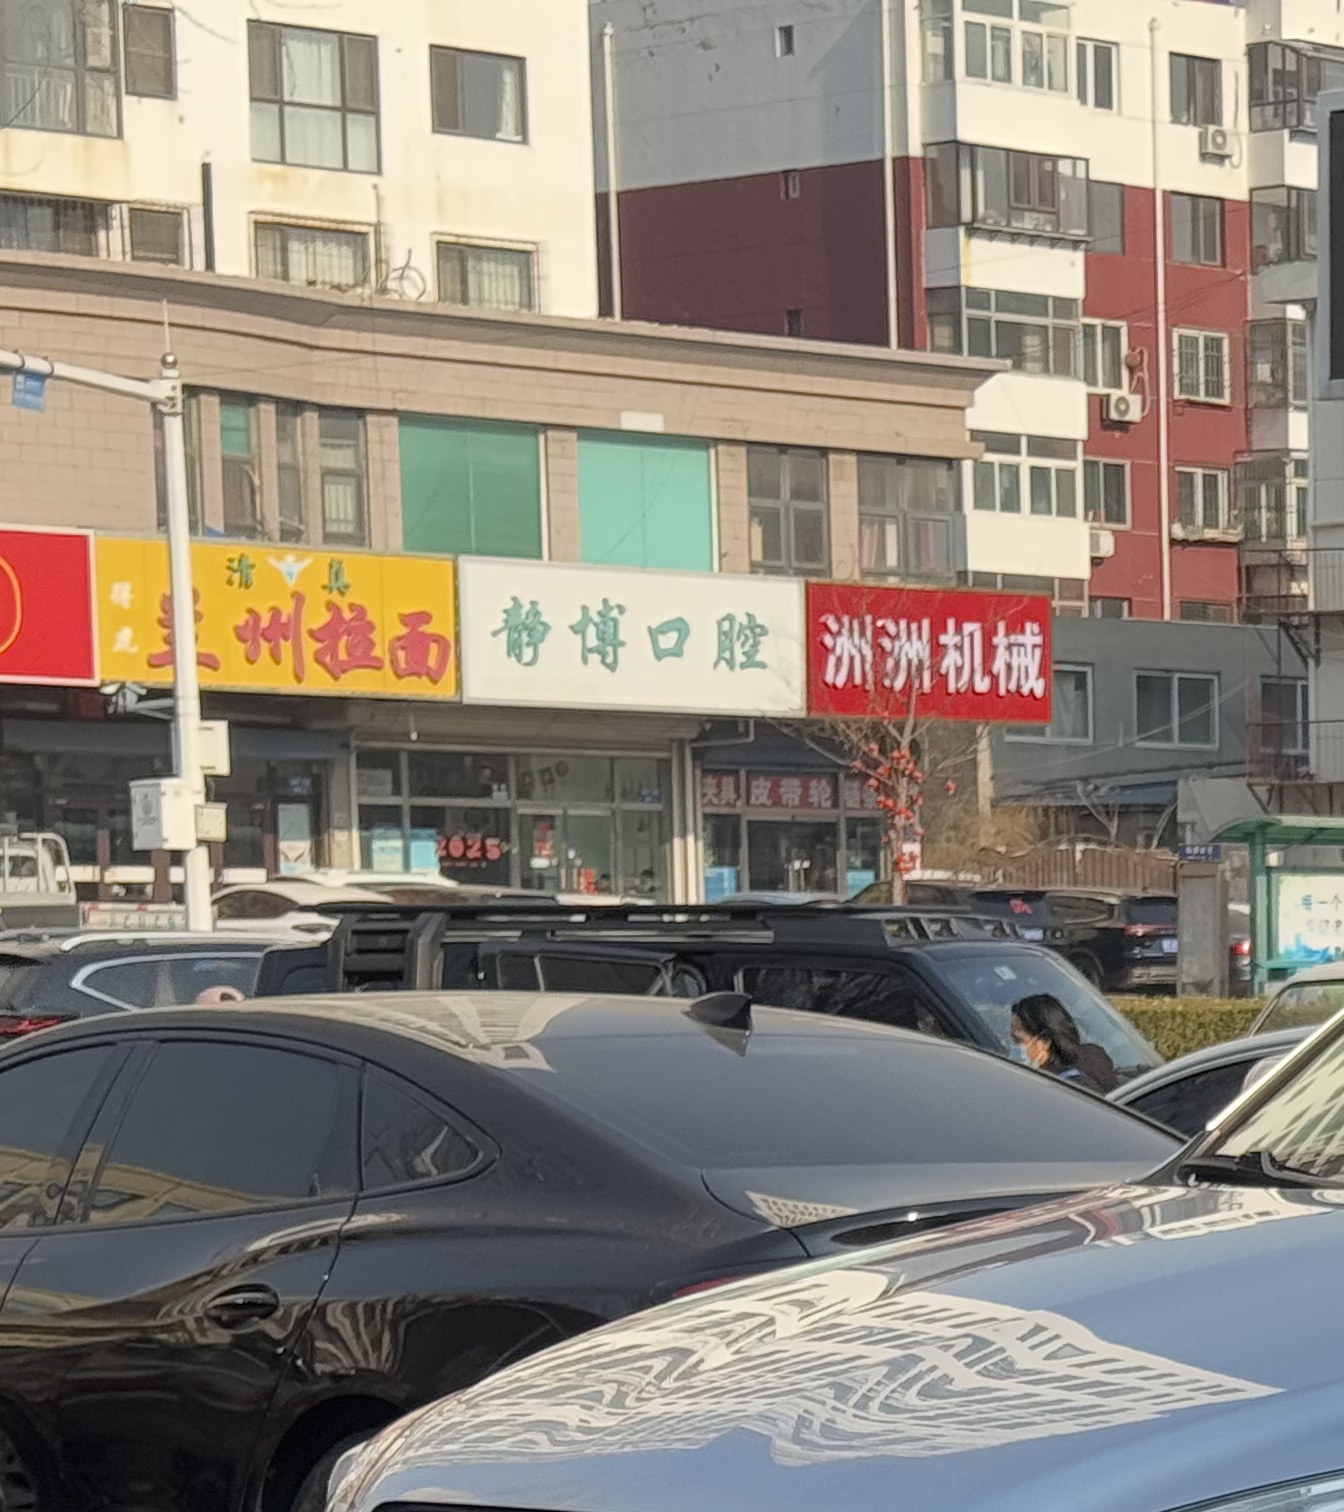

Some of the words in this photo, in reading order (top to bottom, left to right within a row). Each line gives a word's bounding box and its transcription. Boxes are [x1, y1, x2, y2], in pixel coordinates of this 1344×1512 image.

[147, 588, 452, 685] 兰州拉面
[491, 596, 770, 673] 静博口腔
[819, 613, 1047, 699] 洲洲机械
